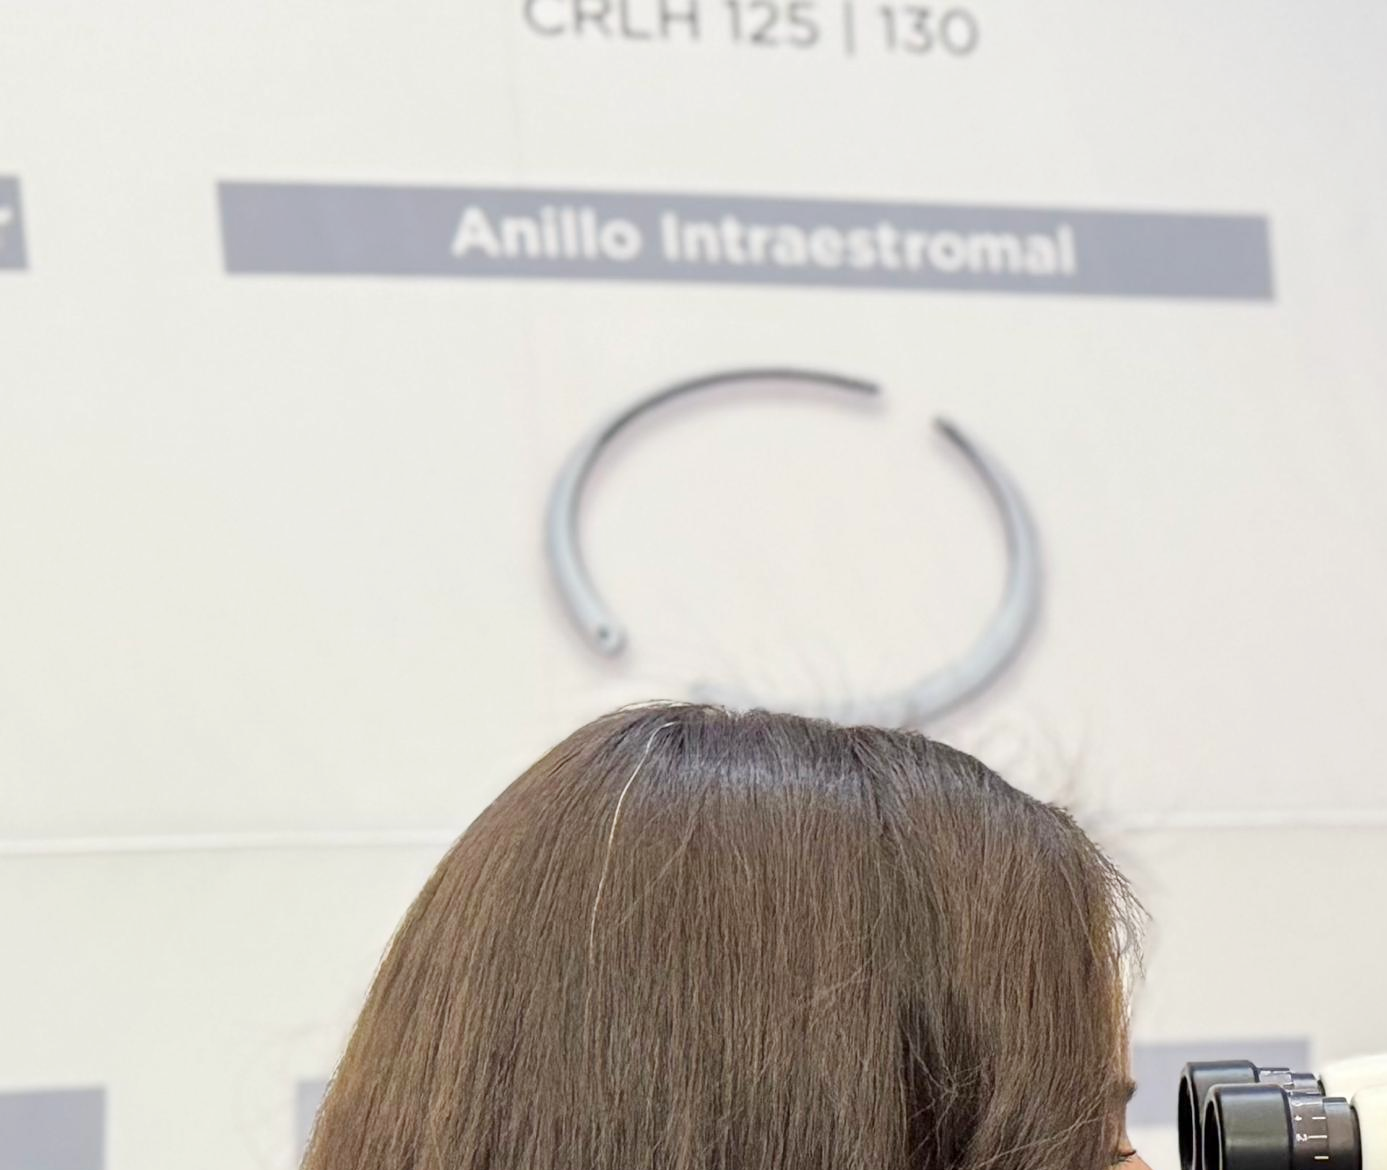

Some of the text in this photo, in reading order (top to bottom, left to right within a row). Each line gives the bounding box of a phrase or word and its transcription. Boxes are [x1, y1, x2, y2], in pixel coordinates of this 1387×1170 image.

[523, 0, 702, 42] CRLH
[729, 0, 820, 50] 125
[878, 5, 980, 58] 130
[450, 207, 1077, 278] Anillo Intraestromal
